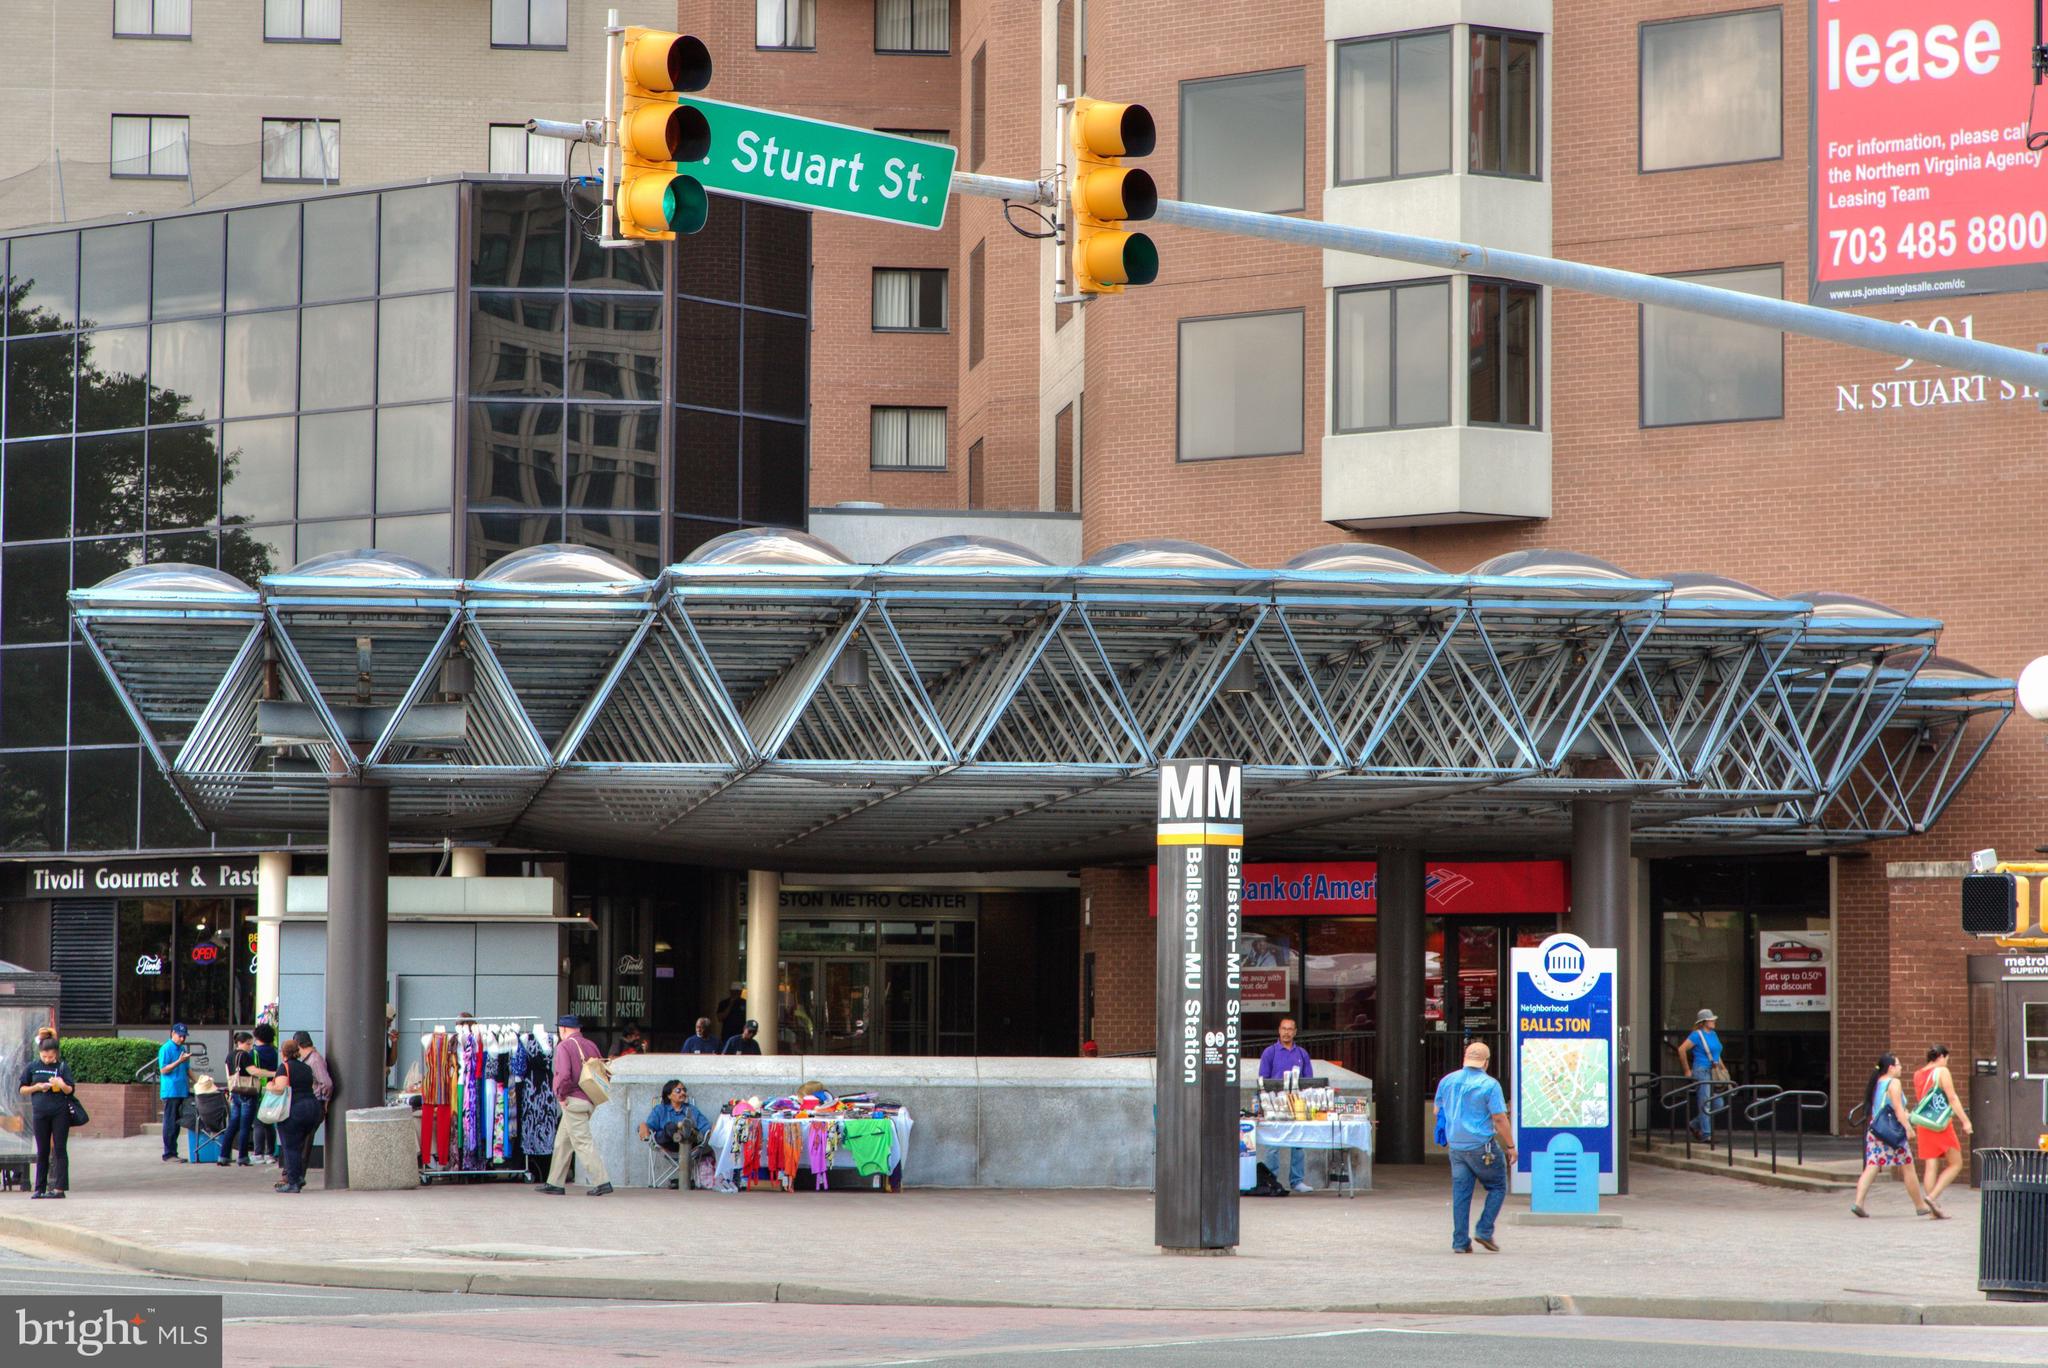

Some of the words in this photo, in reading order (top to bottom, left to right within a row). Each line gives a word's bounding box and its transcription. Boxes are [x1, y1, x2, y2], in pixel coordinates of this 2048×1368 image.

[1828, 19, 2001, 90] lease
[1828, 142, 1854, 159] For
[1857, 133, 1946, 156] information,
[1950, 128, 1999, 150] please
[731, 130, 864, 192] Stuart
[878, 157, 929, 204] St.
[1828, 167, 1852, 184] the
[1855, 162, 1920, 182] Northern
[1924, 153, 1982, 176] Virginia
[1985, 150, 2043, 171] Agency
[1828, 190, 1887, 208] Leasing
[1890, 185, 1930, 203] Team
[1829, 225, 1888, 267] 703
[1897, 218, 1958, 260] 485
[1967, 210, 2047, 255] 8800
[1836, 384, 1864, 412] N.
[1871, 375, 1992, 409] STUART
[1160, 765, 1203, 818] M
[1207, 765, 1241, 818] M
[33, 868, 84, 890] Tivoli
[95, 867, 179, 890] Gourmet
[190, 865, 207, 887] &
[1288, 872, 1313, 900] of
[830, 892, 891, 909] METRO
[899, 893, 967, 909] CENTER
[1185, 847, 1202, 990] Ballston-MU
[1226, 848, 1241, 990] Ballston-MU
[192, 946, 217, 960] OPEN
[1764, 983, 1780, 991] rate
[1781, 982, 1812, 991] discount
[1765, 971, 1779, 981] Get
[1780, 973, 1790, 982] up
[1791, 972, 1800, 980] to
[577, 984, 602, 1000] TIVOLI
[619, 985, 644, 1001] TIVOLI
[570, 1001, 608, 1017] GOURMET
[615, 1002, 646, 1018] PASTRY
[1520, 1003, 1569, 1014] Neighborhood
[1520, 1017, 1591, 1032] BALLSTON
[1184, 999, 1201, 1084] Station
[1226, 999, 1240, 1083] Station
